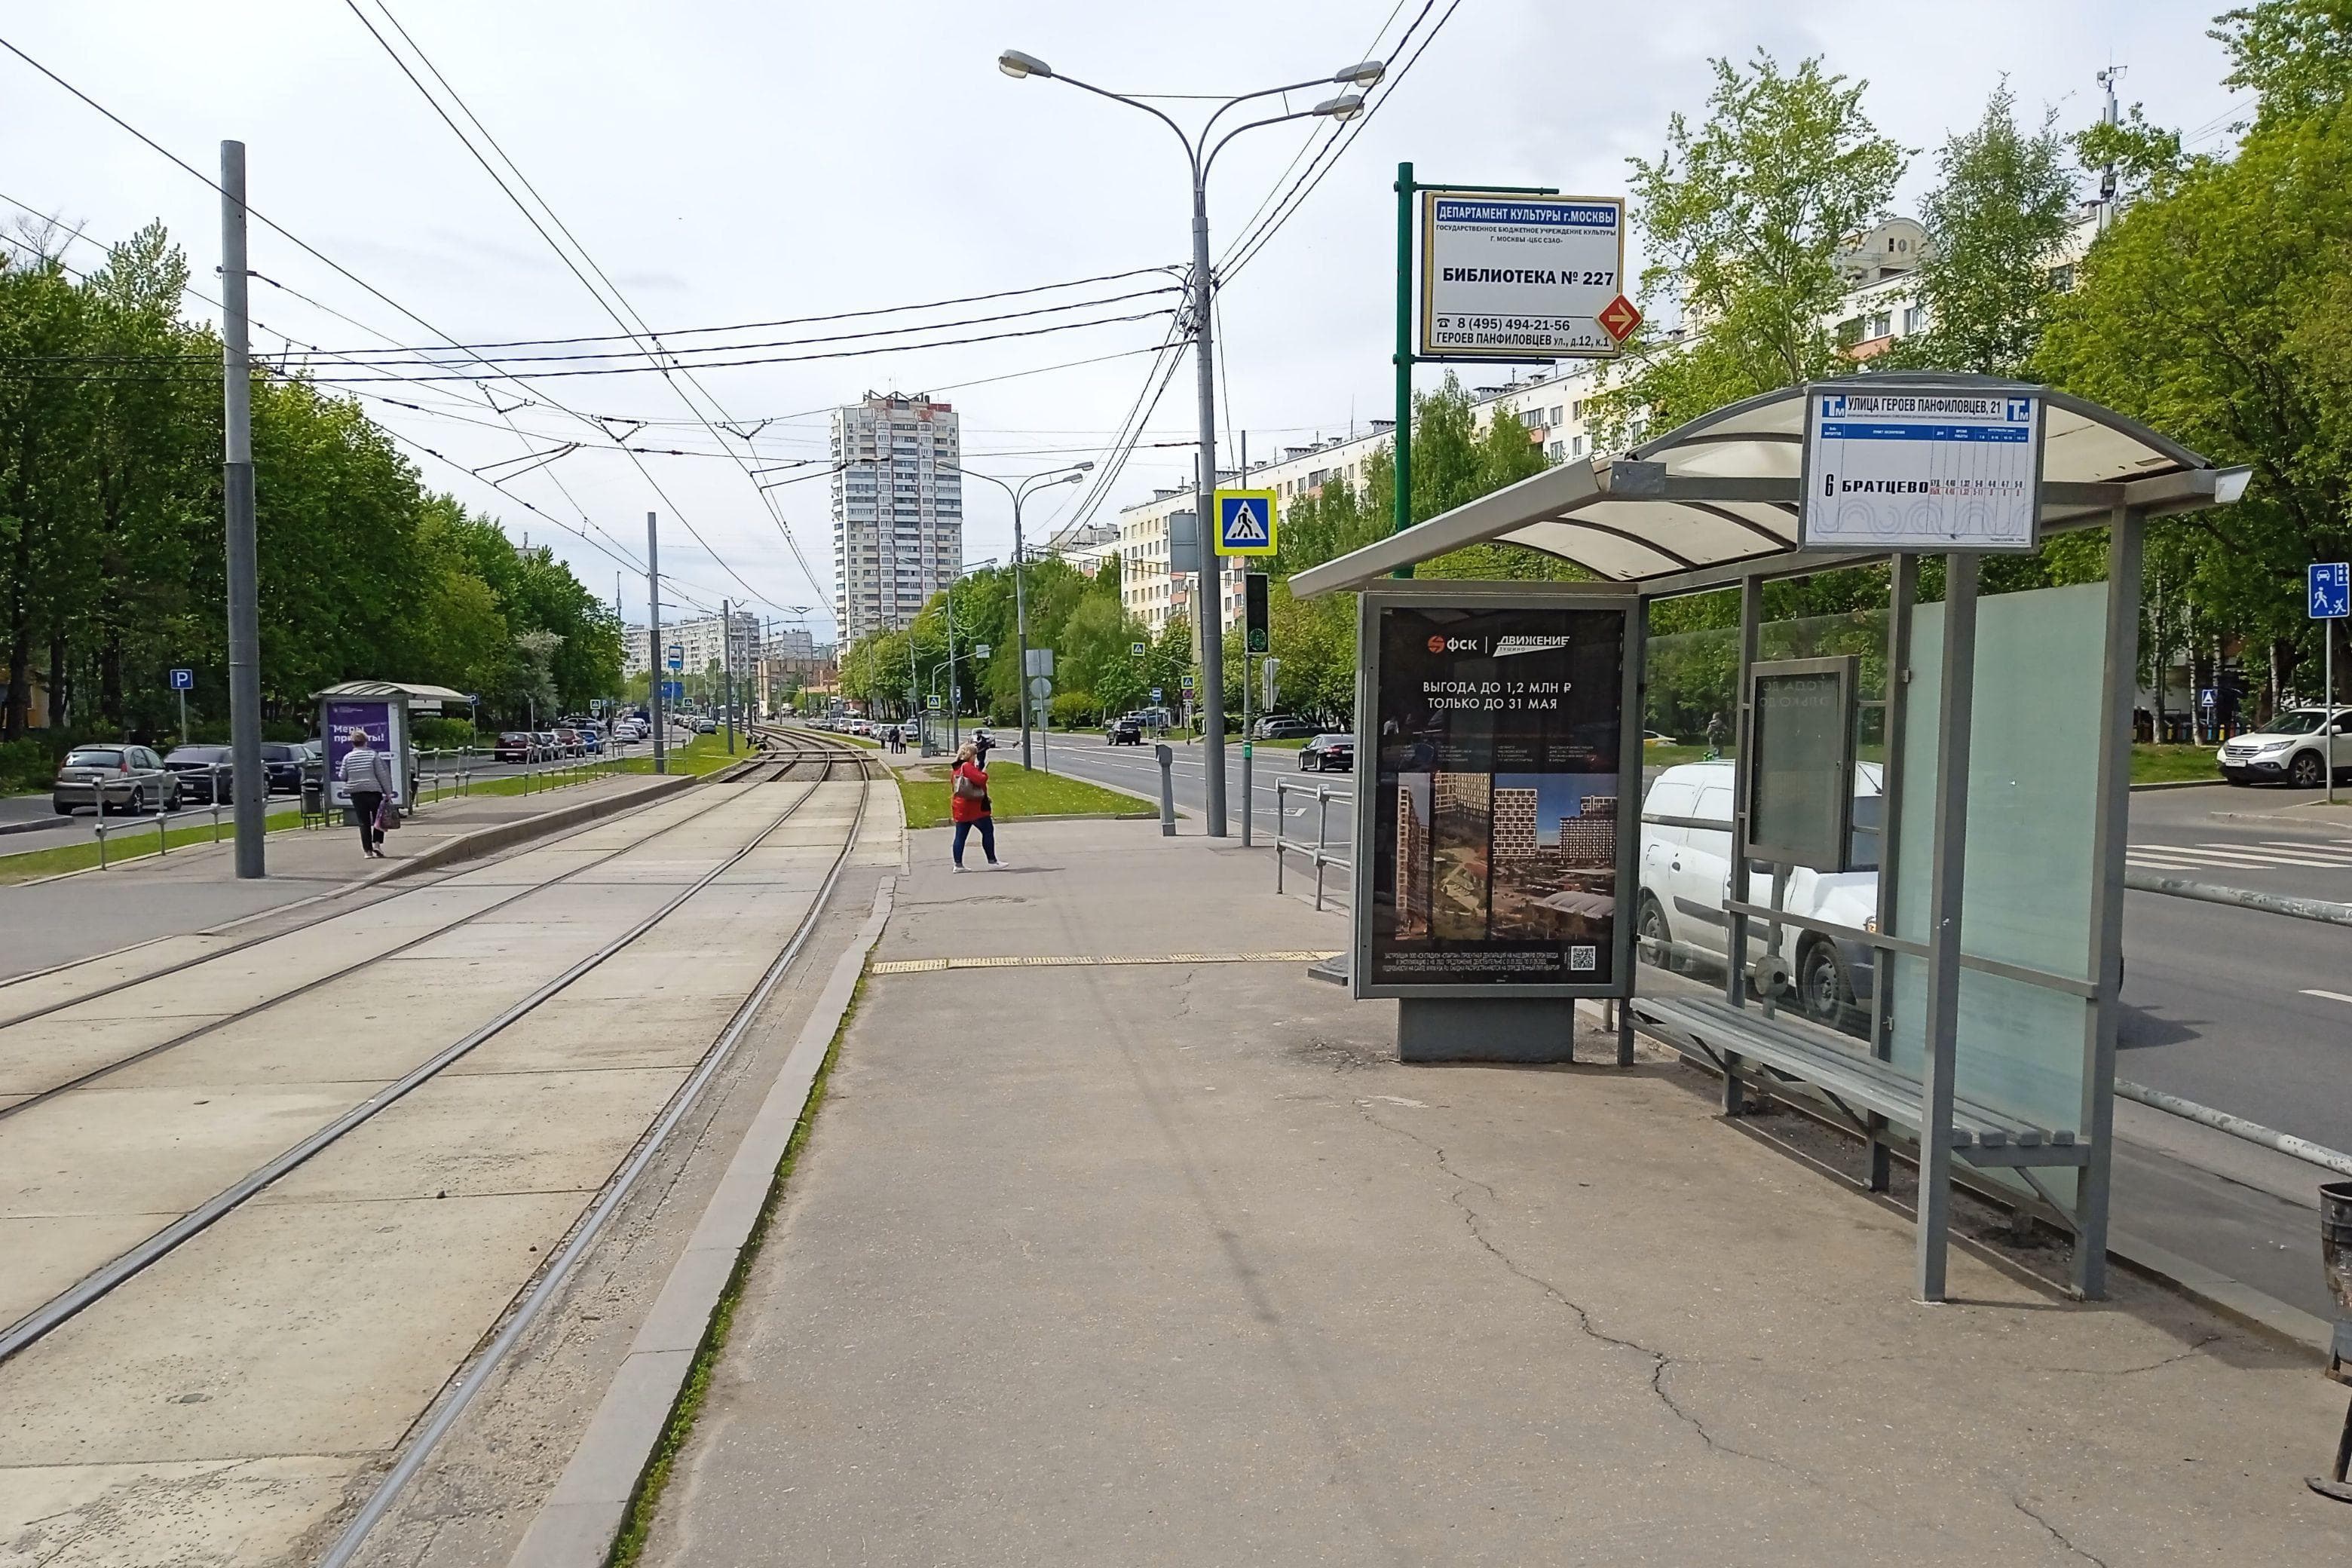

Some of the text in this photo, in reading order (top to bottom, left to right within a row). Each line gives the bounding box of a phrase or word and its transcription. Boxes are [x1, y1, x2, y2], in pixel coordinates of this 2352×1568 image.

[1439, 206, 1613, 224] ДЕПАРТАМЕНТ КУЛЬТУРЫ г.МОСКВЫ
[1436, 225, 1497, 233] ГОСУДАРСТВЕННОЕ
[1498, 226, 1539, 234] БЮДЖЕТНОЕ
[1443, 268, 1614, 286] БИБЛИОТЕКА № 227
[1457, 317, 1570, 332] 8 (495) 494-21-56
[1437, 332, 1474, 344] ГЕРОЕВ
[1476, 332, 1551, 347] ПАНФИЛОВЦЕВ
[1848, 397, 2001, 415] УЛИЦА ГЕРОЕВ ПАНФИЛОВЦЕВ, 21
[1825, 474, 1833, 496] 6
[1842, 480, 1928, 494] БРАТЦЕВО
[1496, 636, 1570, 645] ДВИЖЕНИЕ
[176, 672, 188, 687] P
[1423, 681, 1475, 694] ВЫГОДА
[1481, 682, 1500, 694] ДО
[1507, 682, 1524, 695] 1,2
[1530, 682, 1558, 694] МЛН
[1428, 698, 1557, 710] ТОЛЬКО ДО 31 МАЯ
